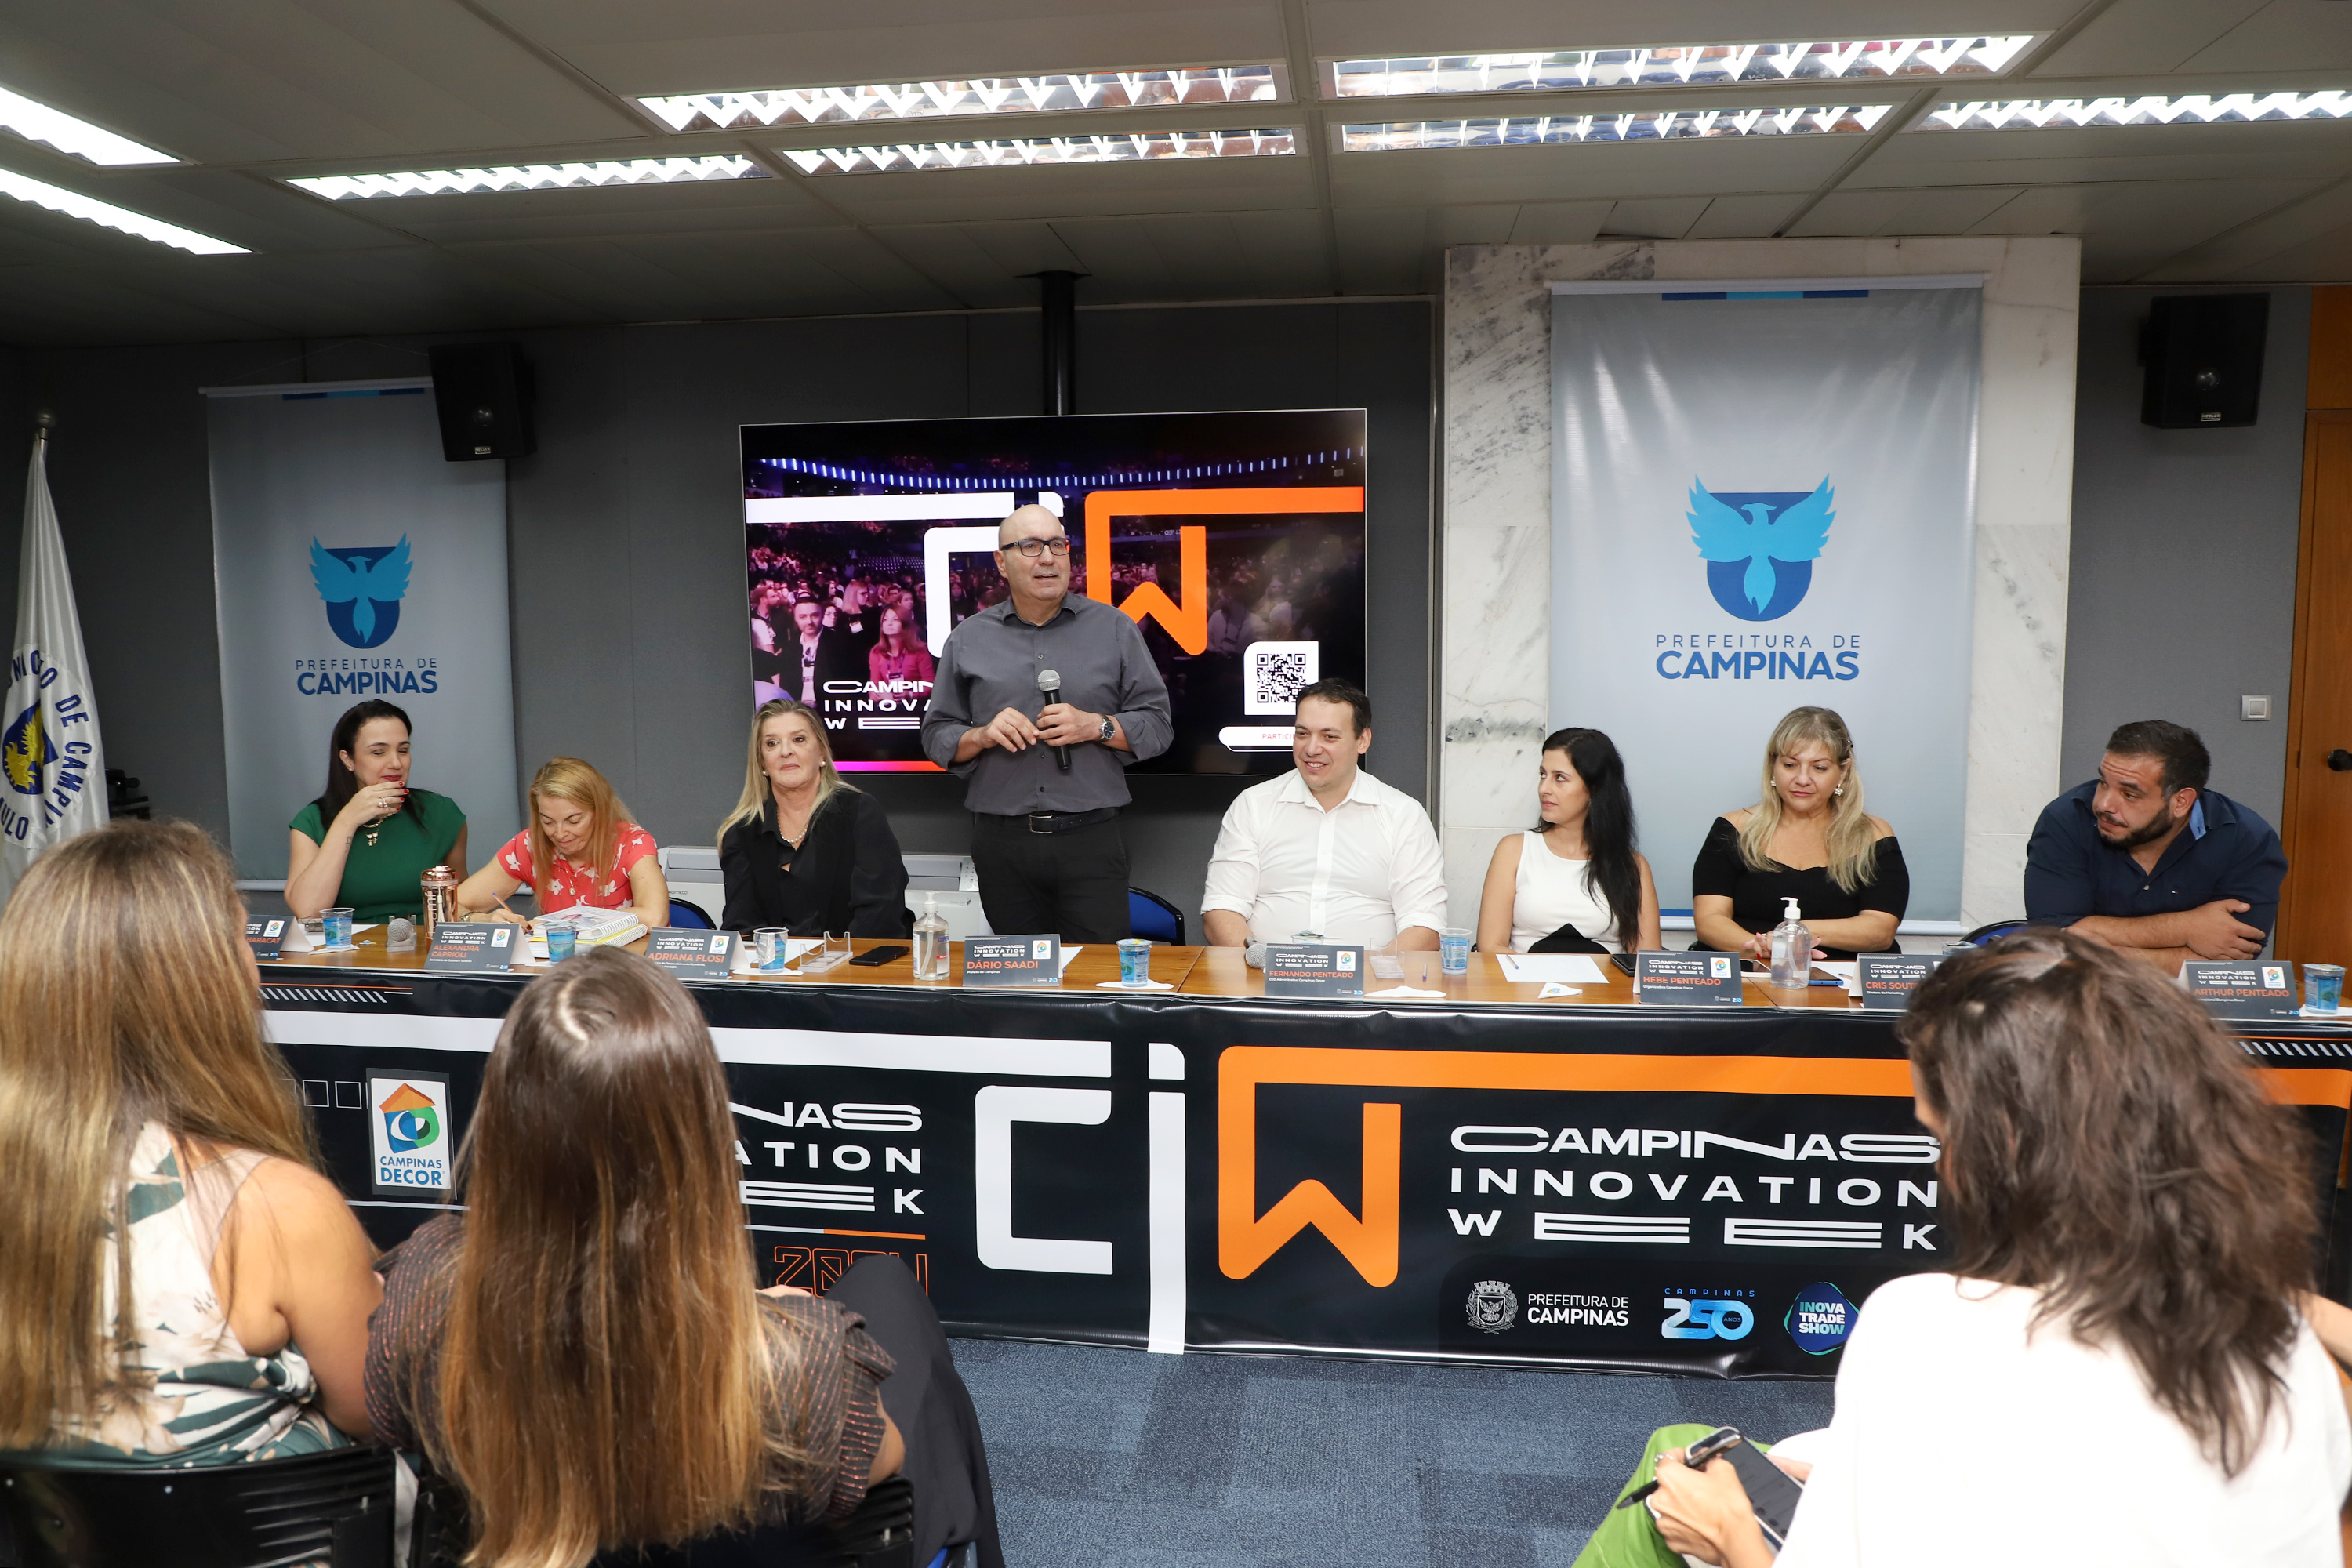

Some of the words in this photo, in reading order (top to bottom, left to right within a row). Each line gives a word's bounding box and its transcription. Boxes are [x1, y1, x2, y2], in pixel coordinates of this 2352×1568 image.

[1656, 634, 1812, 648] PREFEITURA
[1833, 634, 1860, 648] DE
[296, 659, 404, 670] PREFEITURA
[417, 658, 437, 669] DE
[1656, 650, 1860, 681] CAMPINAS
[297, 670, 438, 695] CAMPINAS
[823, 681, 934, 694] CAMPI
[55, 694, 89, 728] DE
[824, 699, 931, 712] INNOV
[648, 952, 694, 961] ADRIANA
[696, 955, 725, 963] FLOSI
[967, 959, 1002, 969] DÁRIO
[1004, 961, 1038, 969] SAADI
[1450, 1125, 1941, 1163] CAMPINAS
[379, 1156, 442, 1169] CAMPINAS
[735, 1140, 921, 1174] ATION
[381, 1168, 443, 1185] DECOR
[1451, 1167, 1938, 1207] INNOVATION
[1447, 1208, 1938, 1250] WEEK
[1664, 1287, 1755, 1298] CAMPINAS
[1528, 1294, 1609, 1308] PREFEITURA
[1611, 1296, 1629, 1308] DE
[1799, 1302, 1846, 1314] INOVA
[1527, 1307, 1629, 1327] CAMPINAS
[1661, 1298, 1754, 1341] 250
[1799, 1312, 1845, 1324] TRADE
[1798, 1322, 1845, 1335] SHOW
